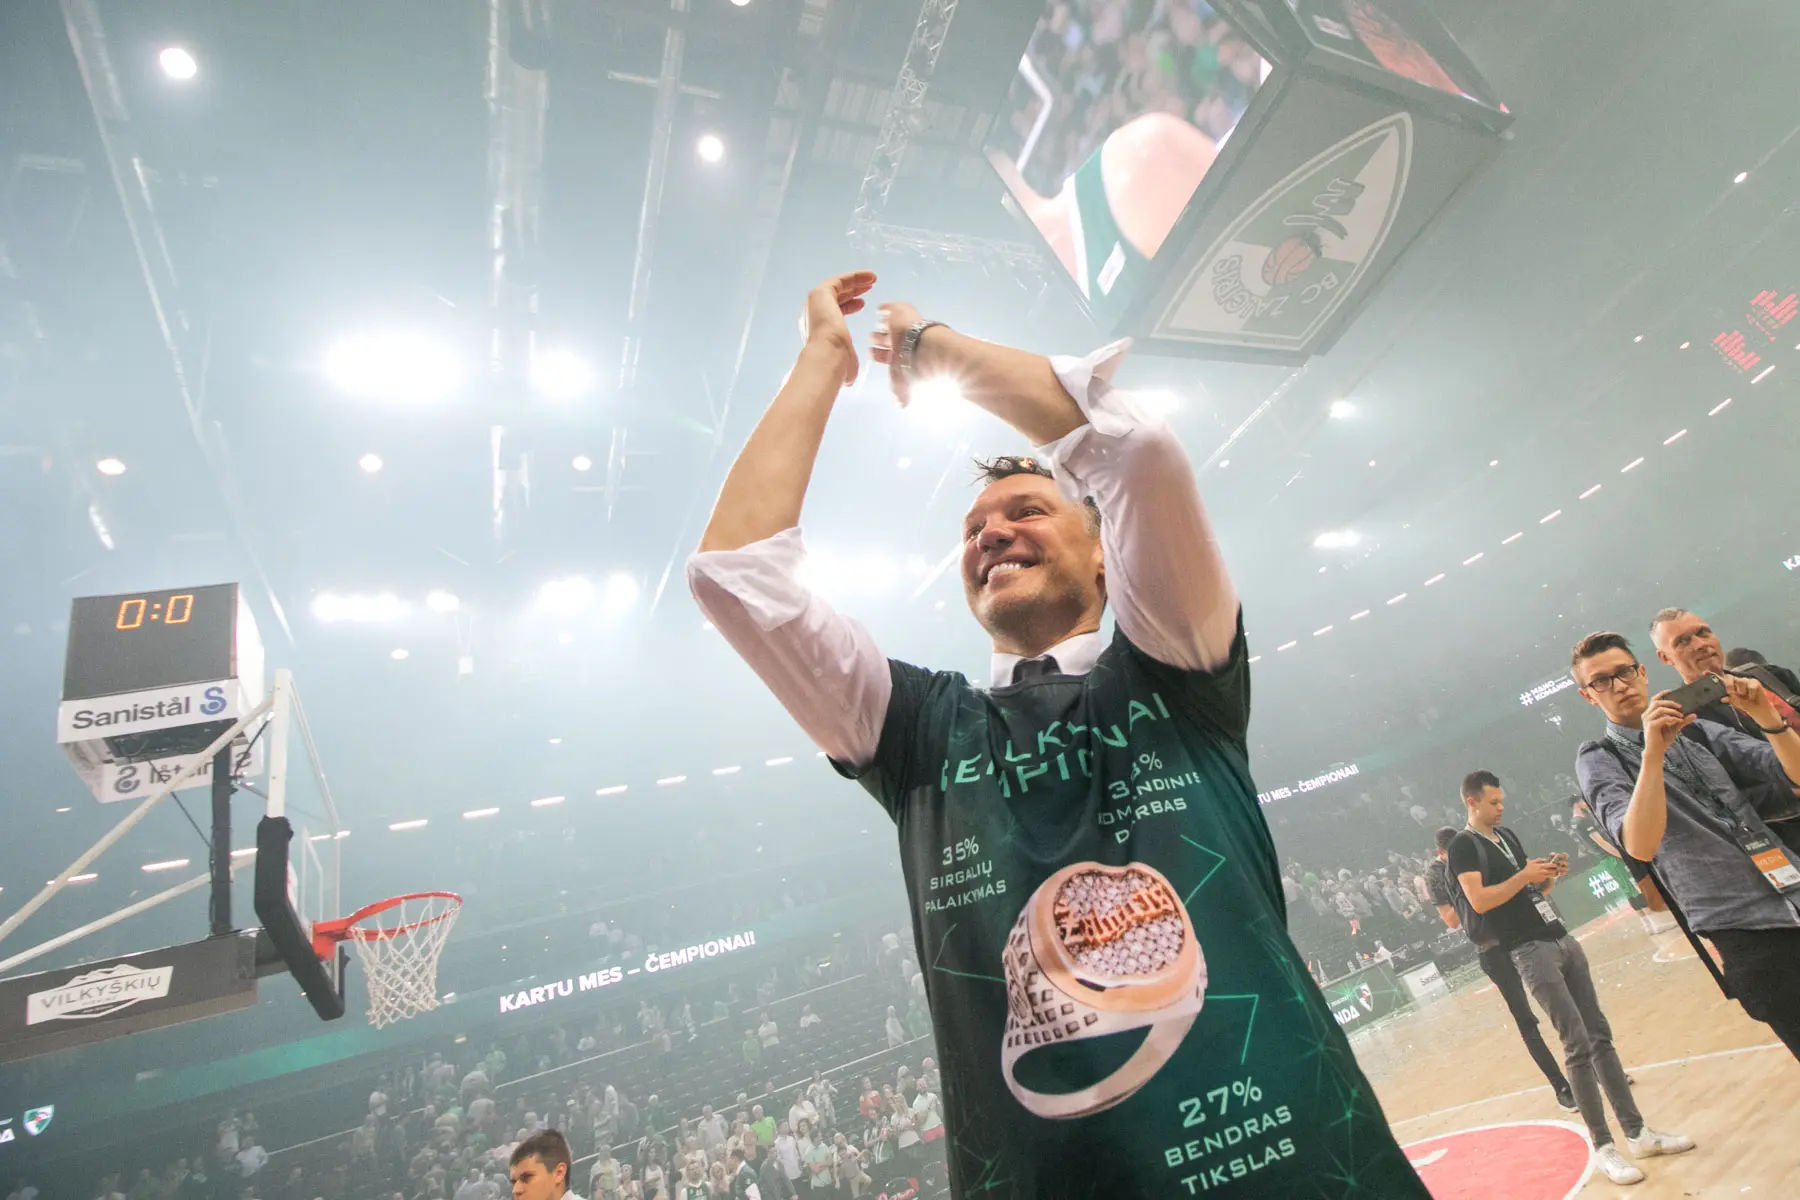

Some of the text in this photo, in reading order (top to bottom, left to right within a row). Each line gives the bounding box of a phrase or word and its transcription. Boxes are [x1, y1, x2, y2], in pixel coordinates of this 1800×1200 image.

[72, 695, 190, 730] Sanistål
[942, 835, 979, 866] 35%
[930, 860, 993, 891] SIRGALIŲ
[925, 879, 1007, 914] PALAIKYMAS
[499, 978, 573, 1013] KARTU
[578, 966, 624, 992] MES
[644, 930, 756, 973] ČEMPIONAI!
[41, 976, 161, 1009] VILKYŠKIŲ
[1179, 1076, 1263, 1128] 27%
[1164, 1105, 1293, 1168] BENDRAS
[1181, 1138, 1297, 1196] TIKSLAS
